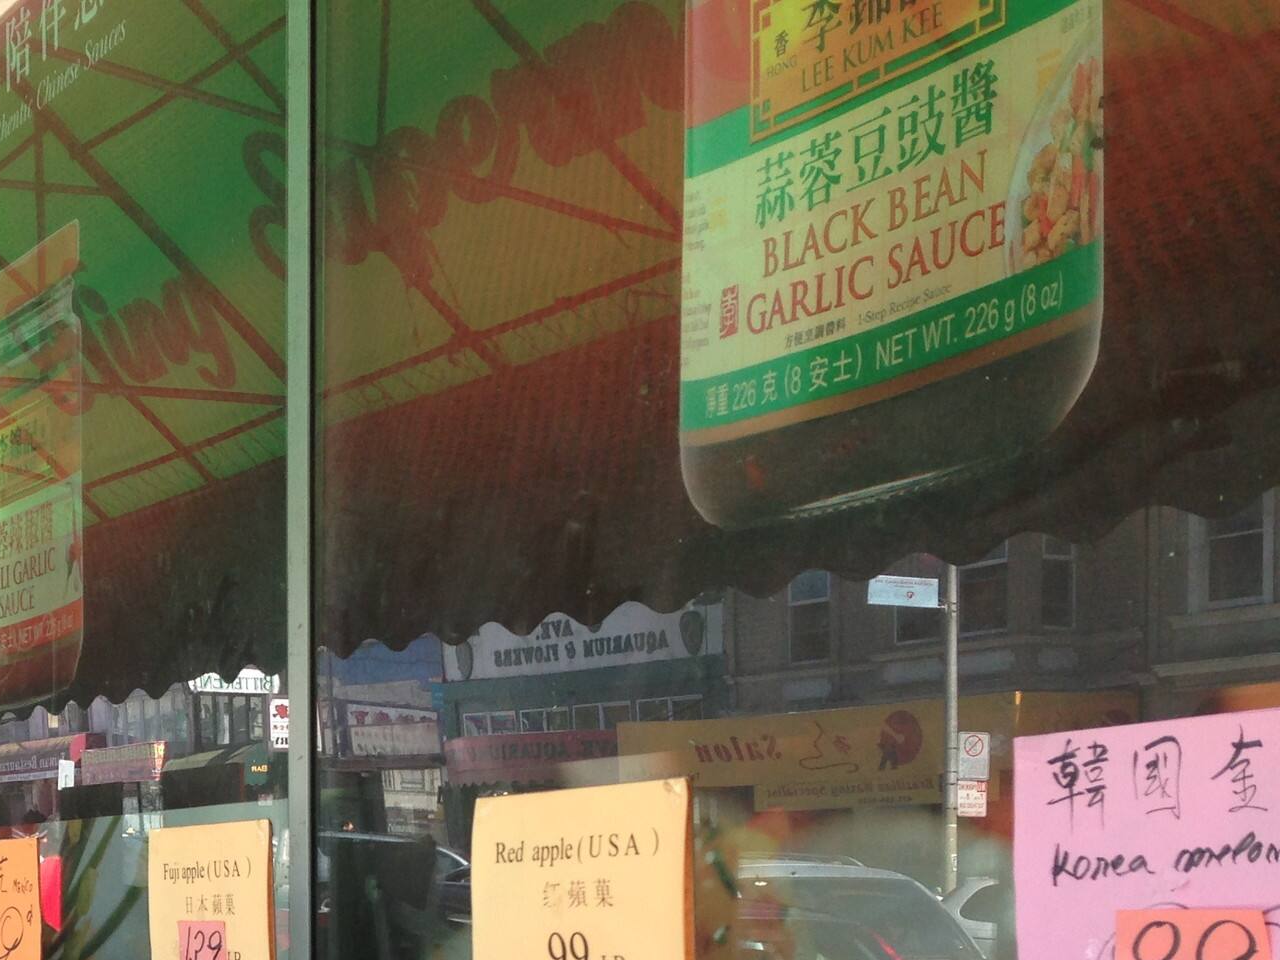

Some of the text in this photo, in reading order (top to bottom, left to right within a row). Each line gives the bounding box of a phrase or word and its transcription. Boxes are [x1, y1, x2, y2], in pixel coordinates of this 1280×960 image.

[36, 59, 81, 110] Chinese
[84, 20, 126, 70] Sauces
[801, 3, 943, 93] LEE KUM KEE
[762, 197, 878, 279] BLACK
[887, 149, 988, 232] BEAN
[746, 255, 874, 335] GARLIC
[887, 201, 1006, 290] SAUCE
[876, 328, 918, 371] NET
[922, 313, 958, 352] WT.
[964, 298, 1000, 339] 226
[1004, 298, 1015, 332] g
[1040, 270, 1064, 311] oz)
[0, 586, 36, 619] SAUCE
[13, 547, 56, 587] GARLIC
[163, 862, 179, 884] Fuji
[495, 841, 524, 863] Red
